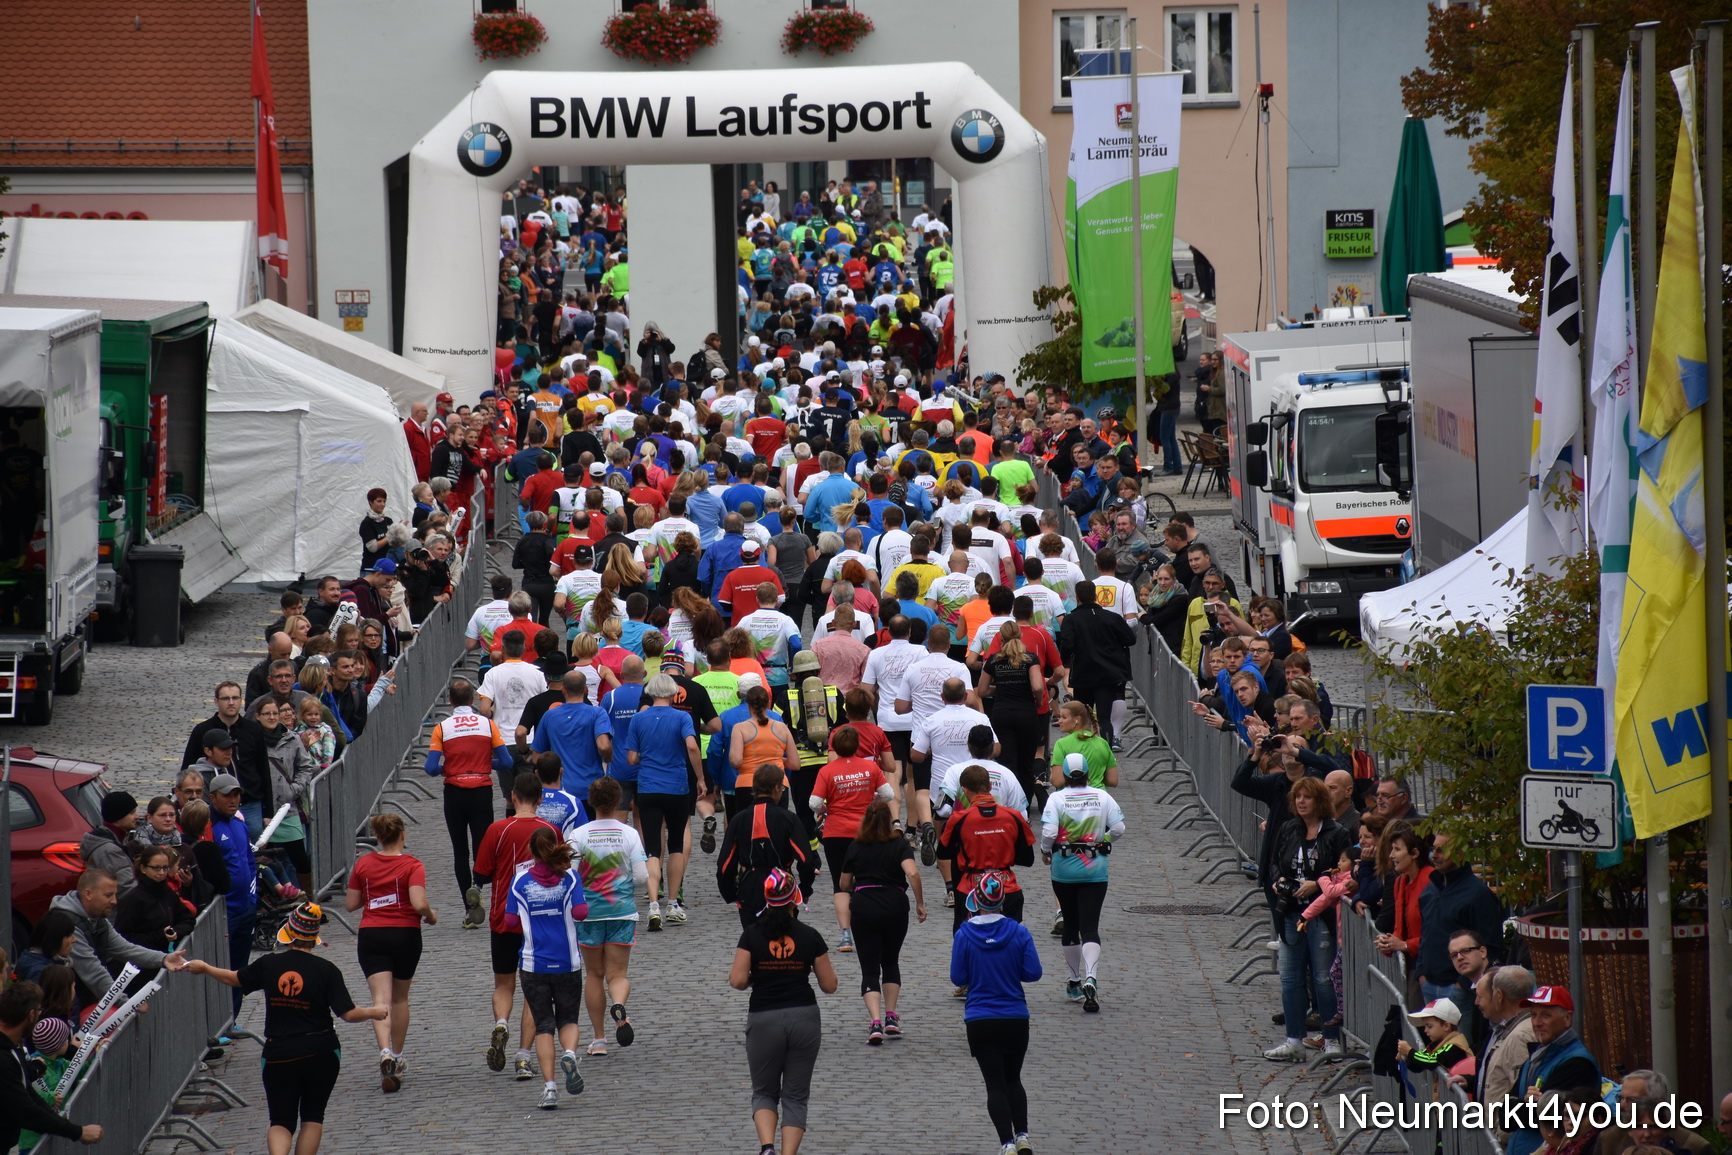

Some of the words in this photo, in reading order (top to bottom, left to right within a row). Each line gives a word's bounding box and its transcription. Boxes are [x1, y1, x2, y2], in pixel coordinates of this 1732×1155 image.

[530, 96, 672, 139] BMW
[686, 91, 932, 143] Laufsport
[955, 109, 999, 130] BMW
[463, 123, 508, 143] BMW
[1098, 134, 1158, 147] Neumakter
[1328, 232, 1371, 242] FRISEUR
[1328, 246, 1347, 254] Inh.
[1349, 245, 1371, 254] Held
[821, 272, 839, 285] 15
[880, 271, 892, 282] 8
[412, 346, 489, 357] www.bmw-laufsport.de
[1308, 418, 1335, 426] 44/54/1
[1336, 500, 1388, 510] Bayerisches
[453, 714, 479, 724] TAO
[1547, 697, 1588, 760] P
[834, 775, 844, 783] Fit
[845, 772, 864, 780] nach
[1554, 785, 1583, 799] nur
[80, 1010, 101, 1034] BMW
[98, 968, 134, 1011] Laufsport
